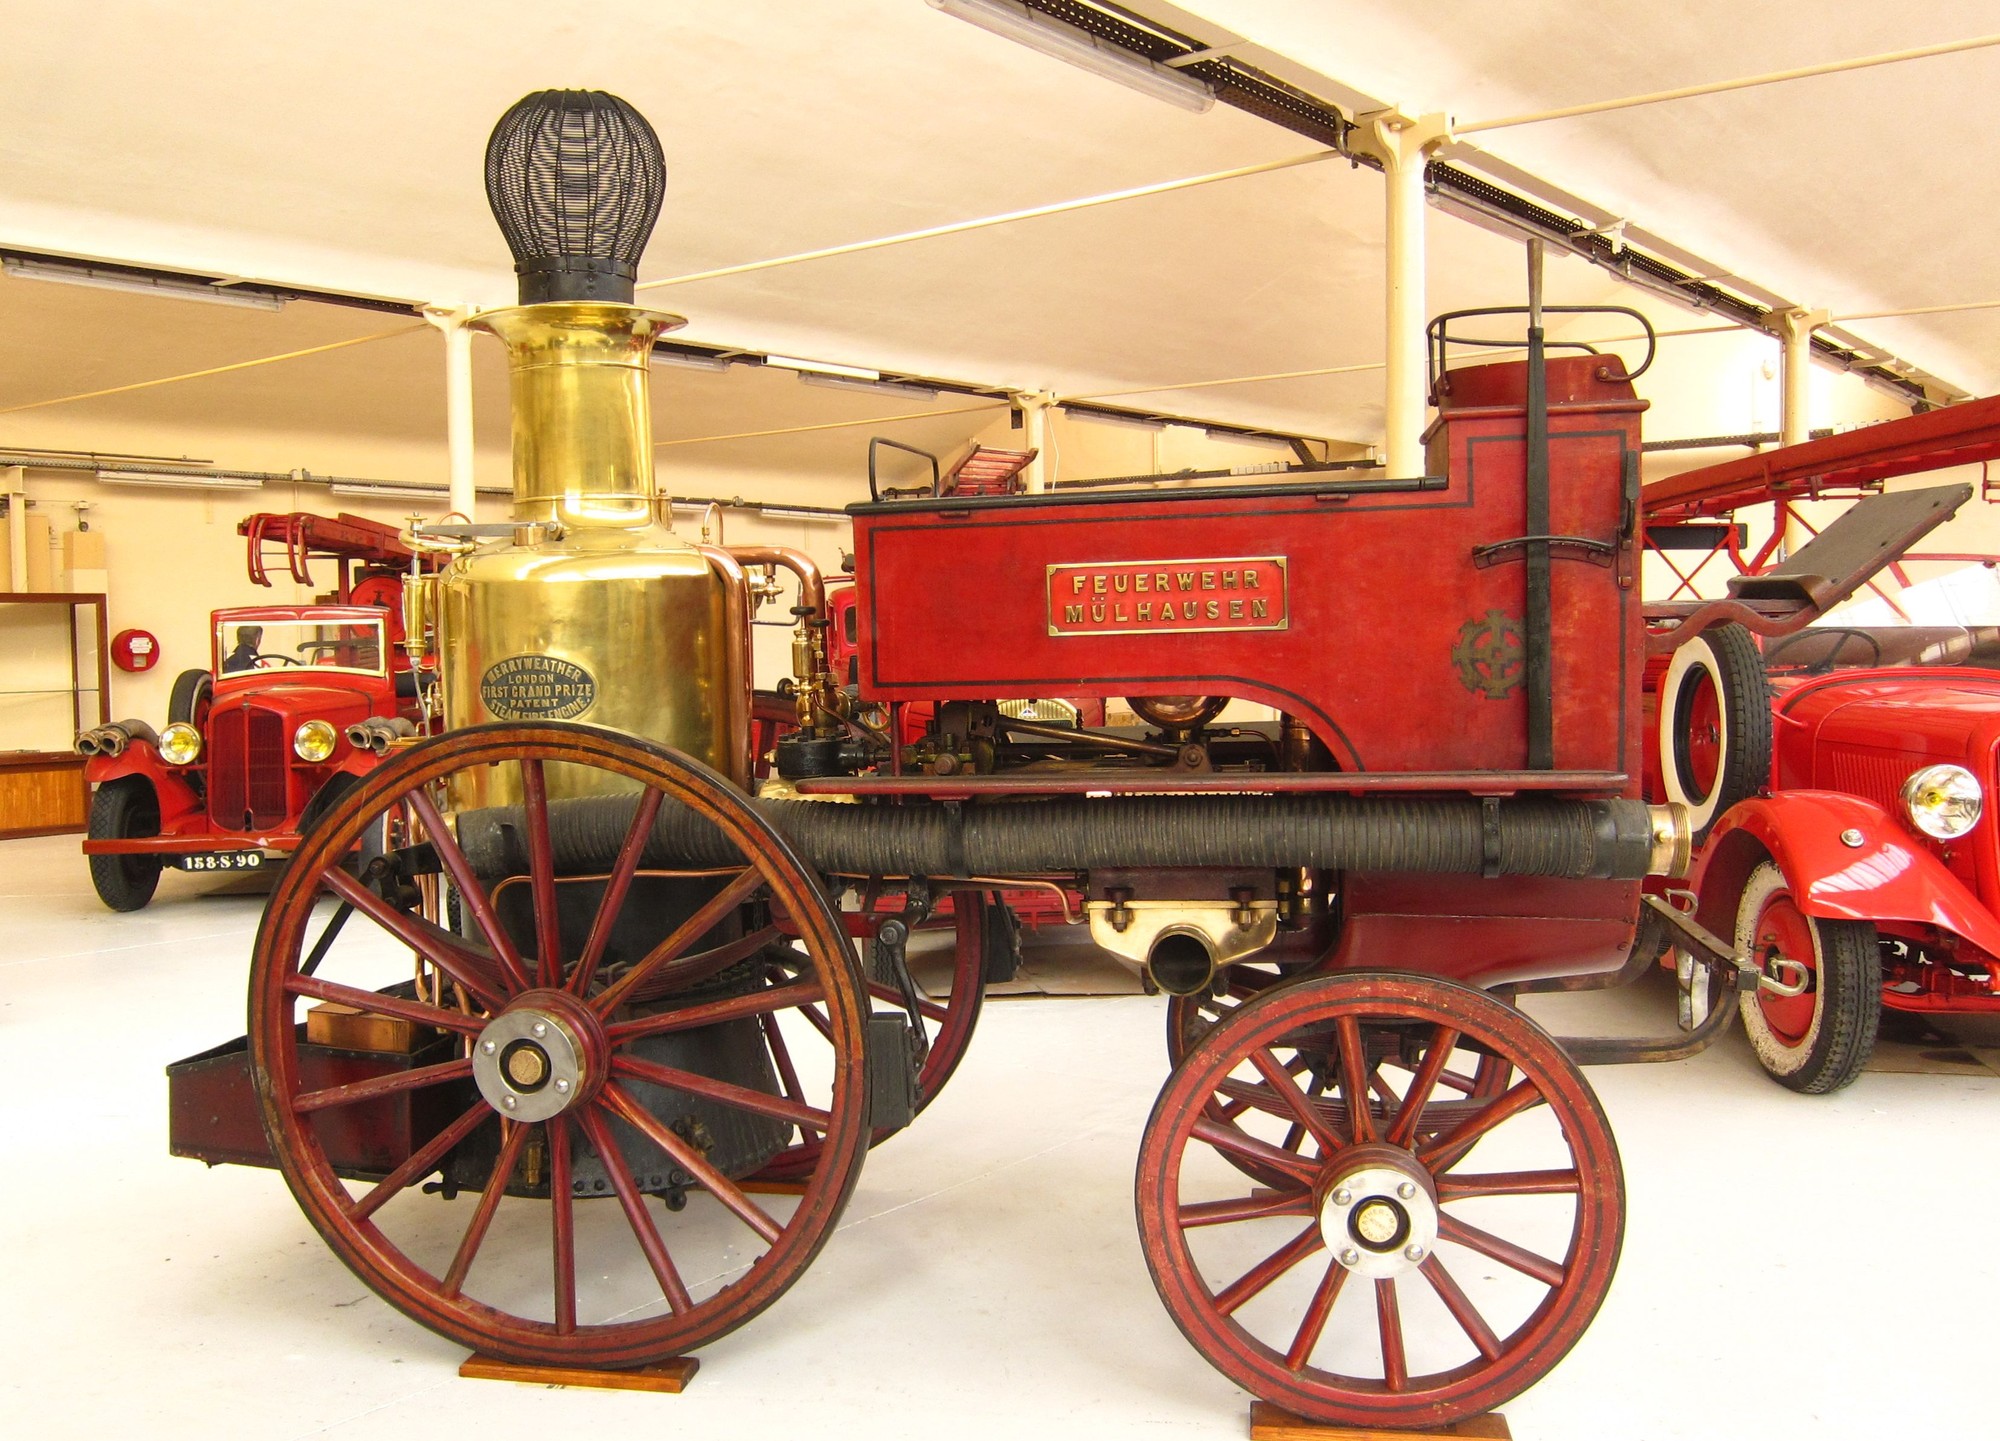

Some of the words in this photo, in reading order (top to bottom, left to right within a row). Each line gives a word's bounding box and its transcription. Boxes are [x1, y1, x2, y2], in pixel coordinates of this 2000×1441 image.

[1073, 570, 1259, 594] FEUERWEHR
[1065, 597, 1267, 623] MÜLHAUSEN
[486, 657, 582, 684] MERRYWEATHER
[508, 674, 554, 684] LONDON
[482, 686, 508, 698] FIRST
[511, 686, 551, 698] GRAND
[555, 684, 592, 697] PRIZE
[489, 699, 520, 720] STEAM
[510, 698, 559, 708] PATENT
